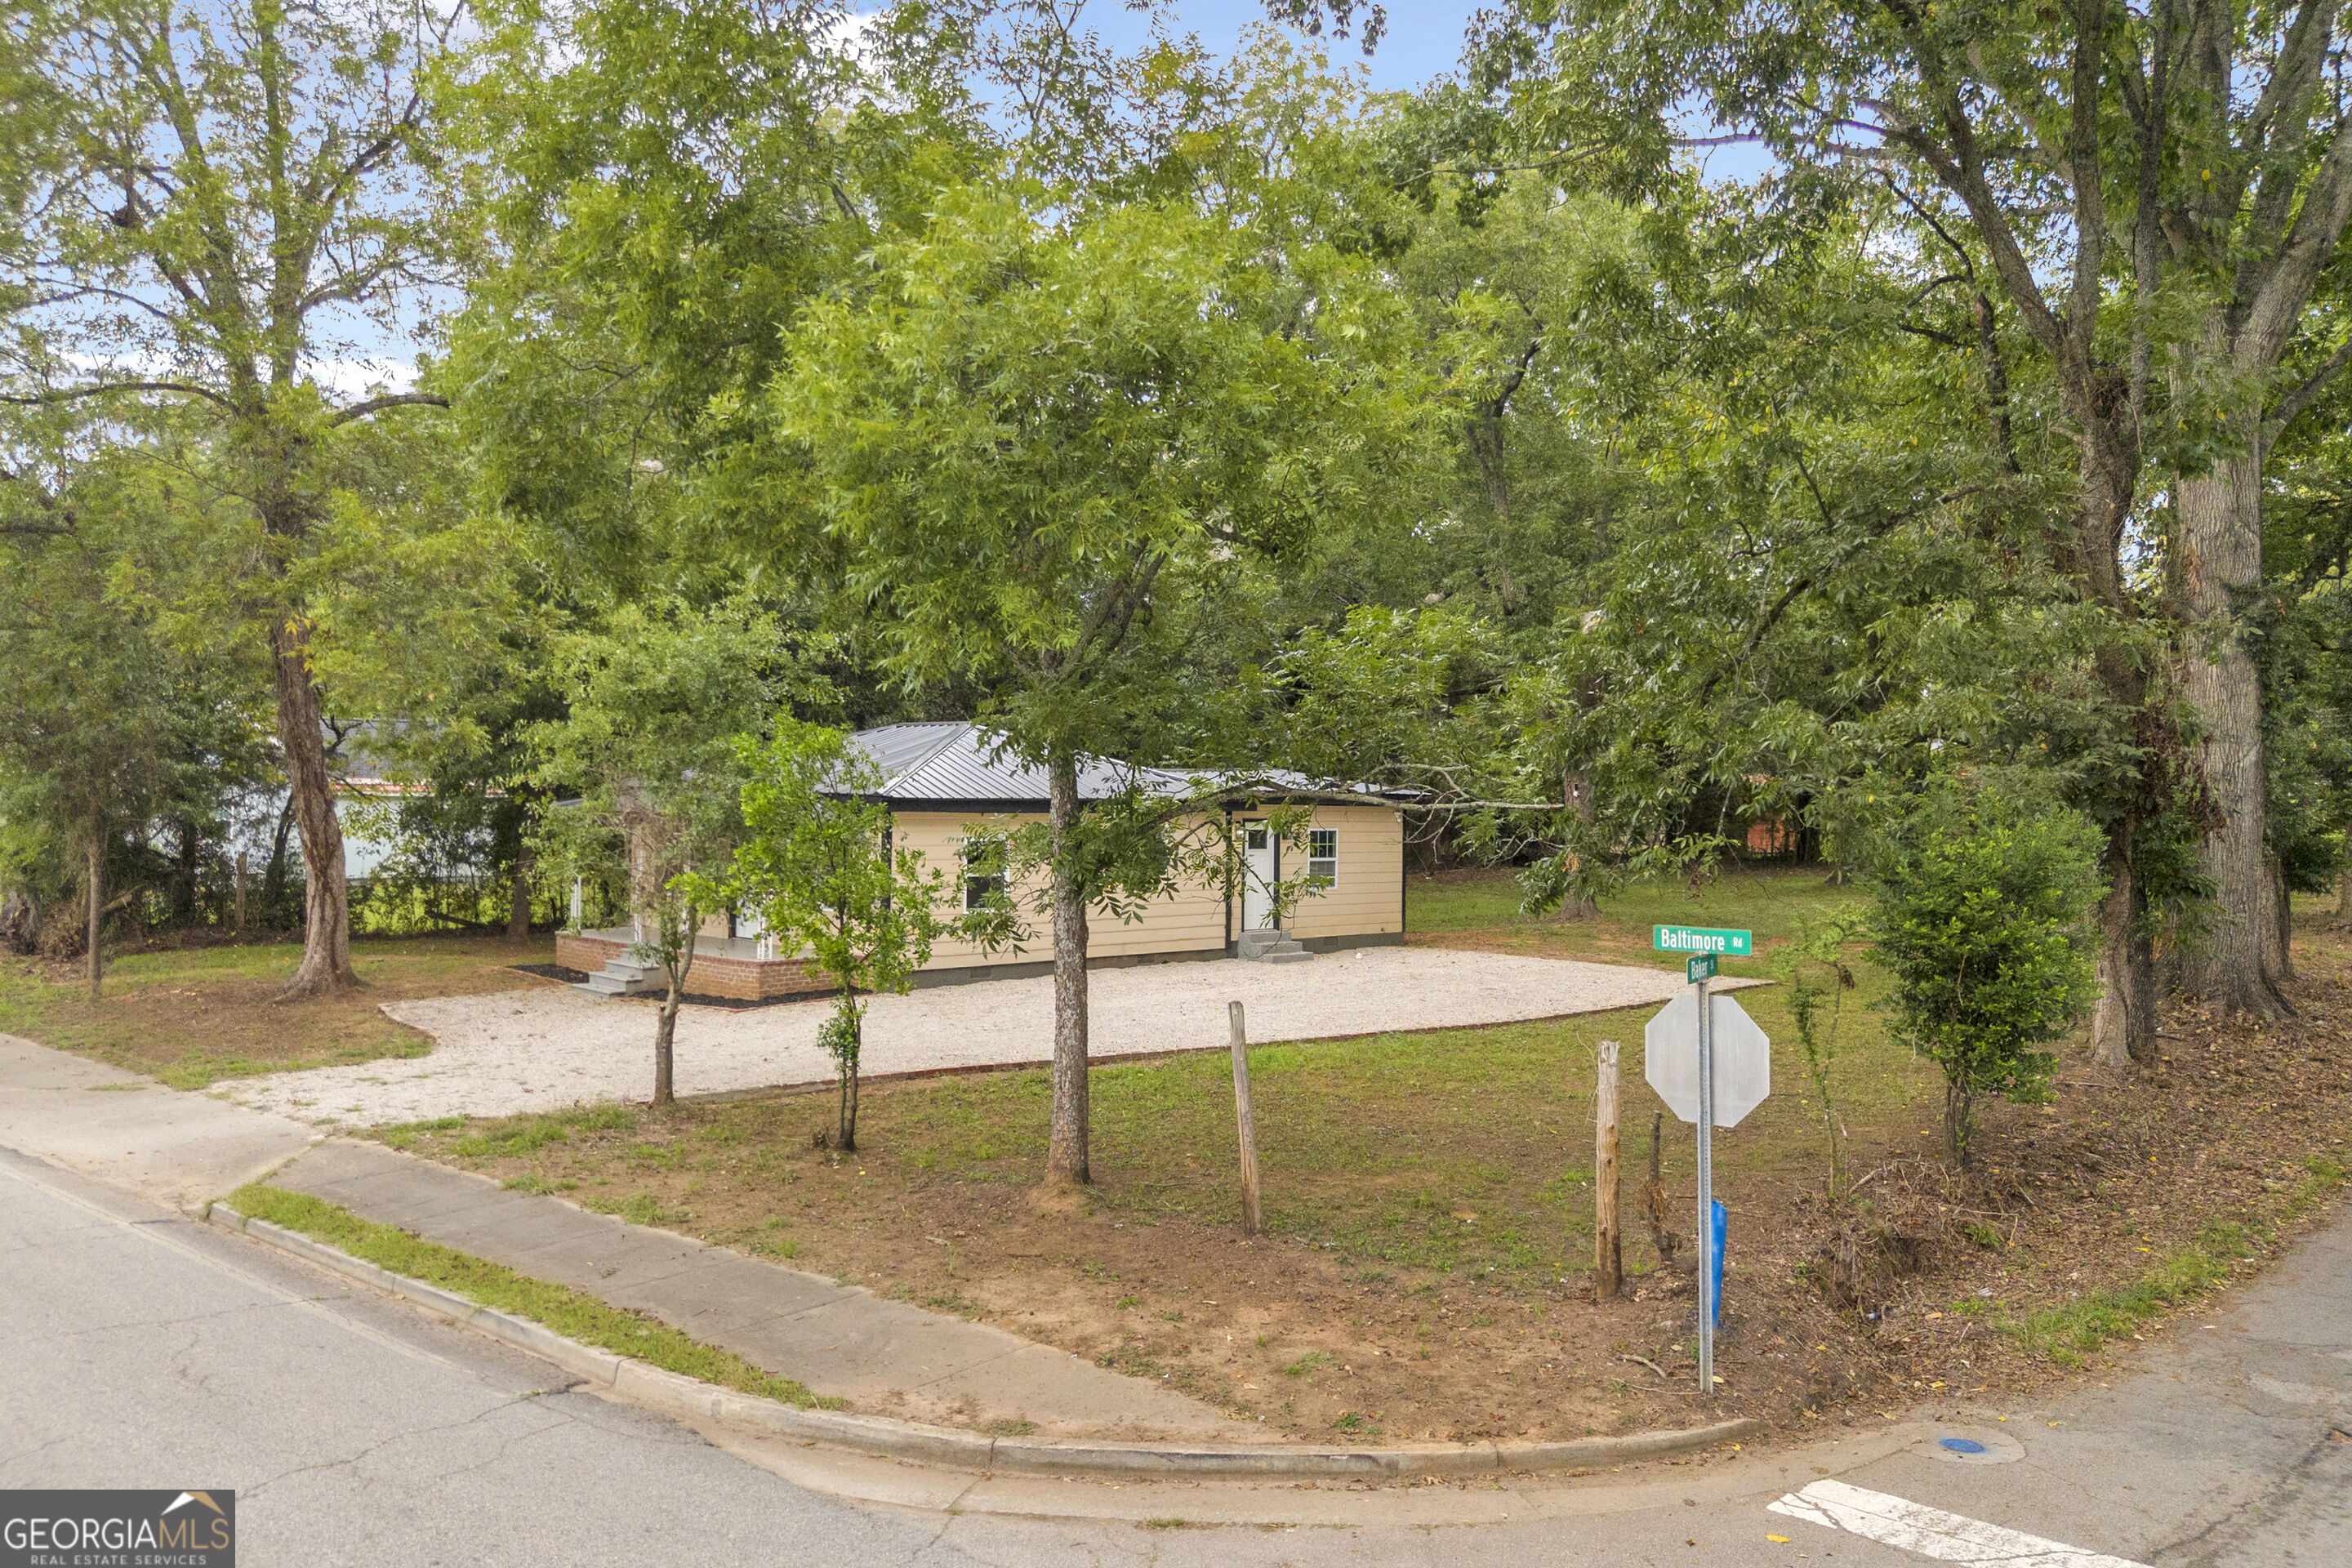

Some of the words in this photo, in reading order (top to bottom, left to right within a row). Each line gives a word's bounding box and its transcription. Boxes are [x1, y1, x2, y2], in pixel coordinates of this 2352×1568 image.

[1661, 929, 1725, 951] Baltimore
[1733, 937, 1743, 947] Rd
[1691, 960, 1708, 979] Baker
